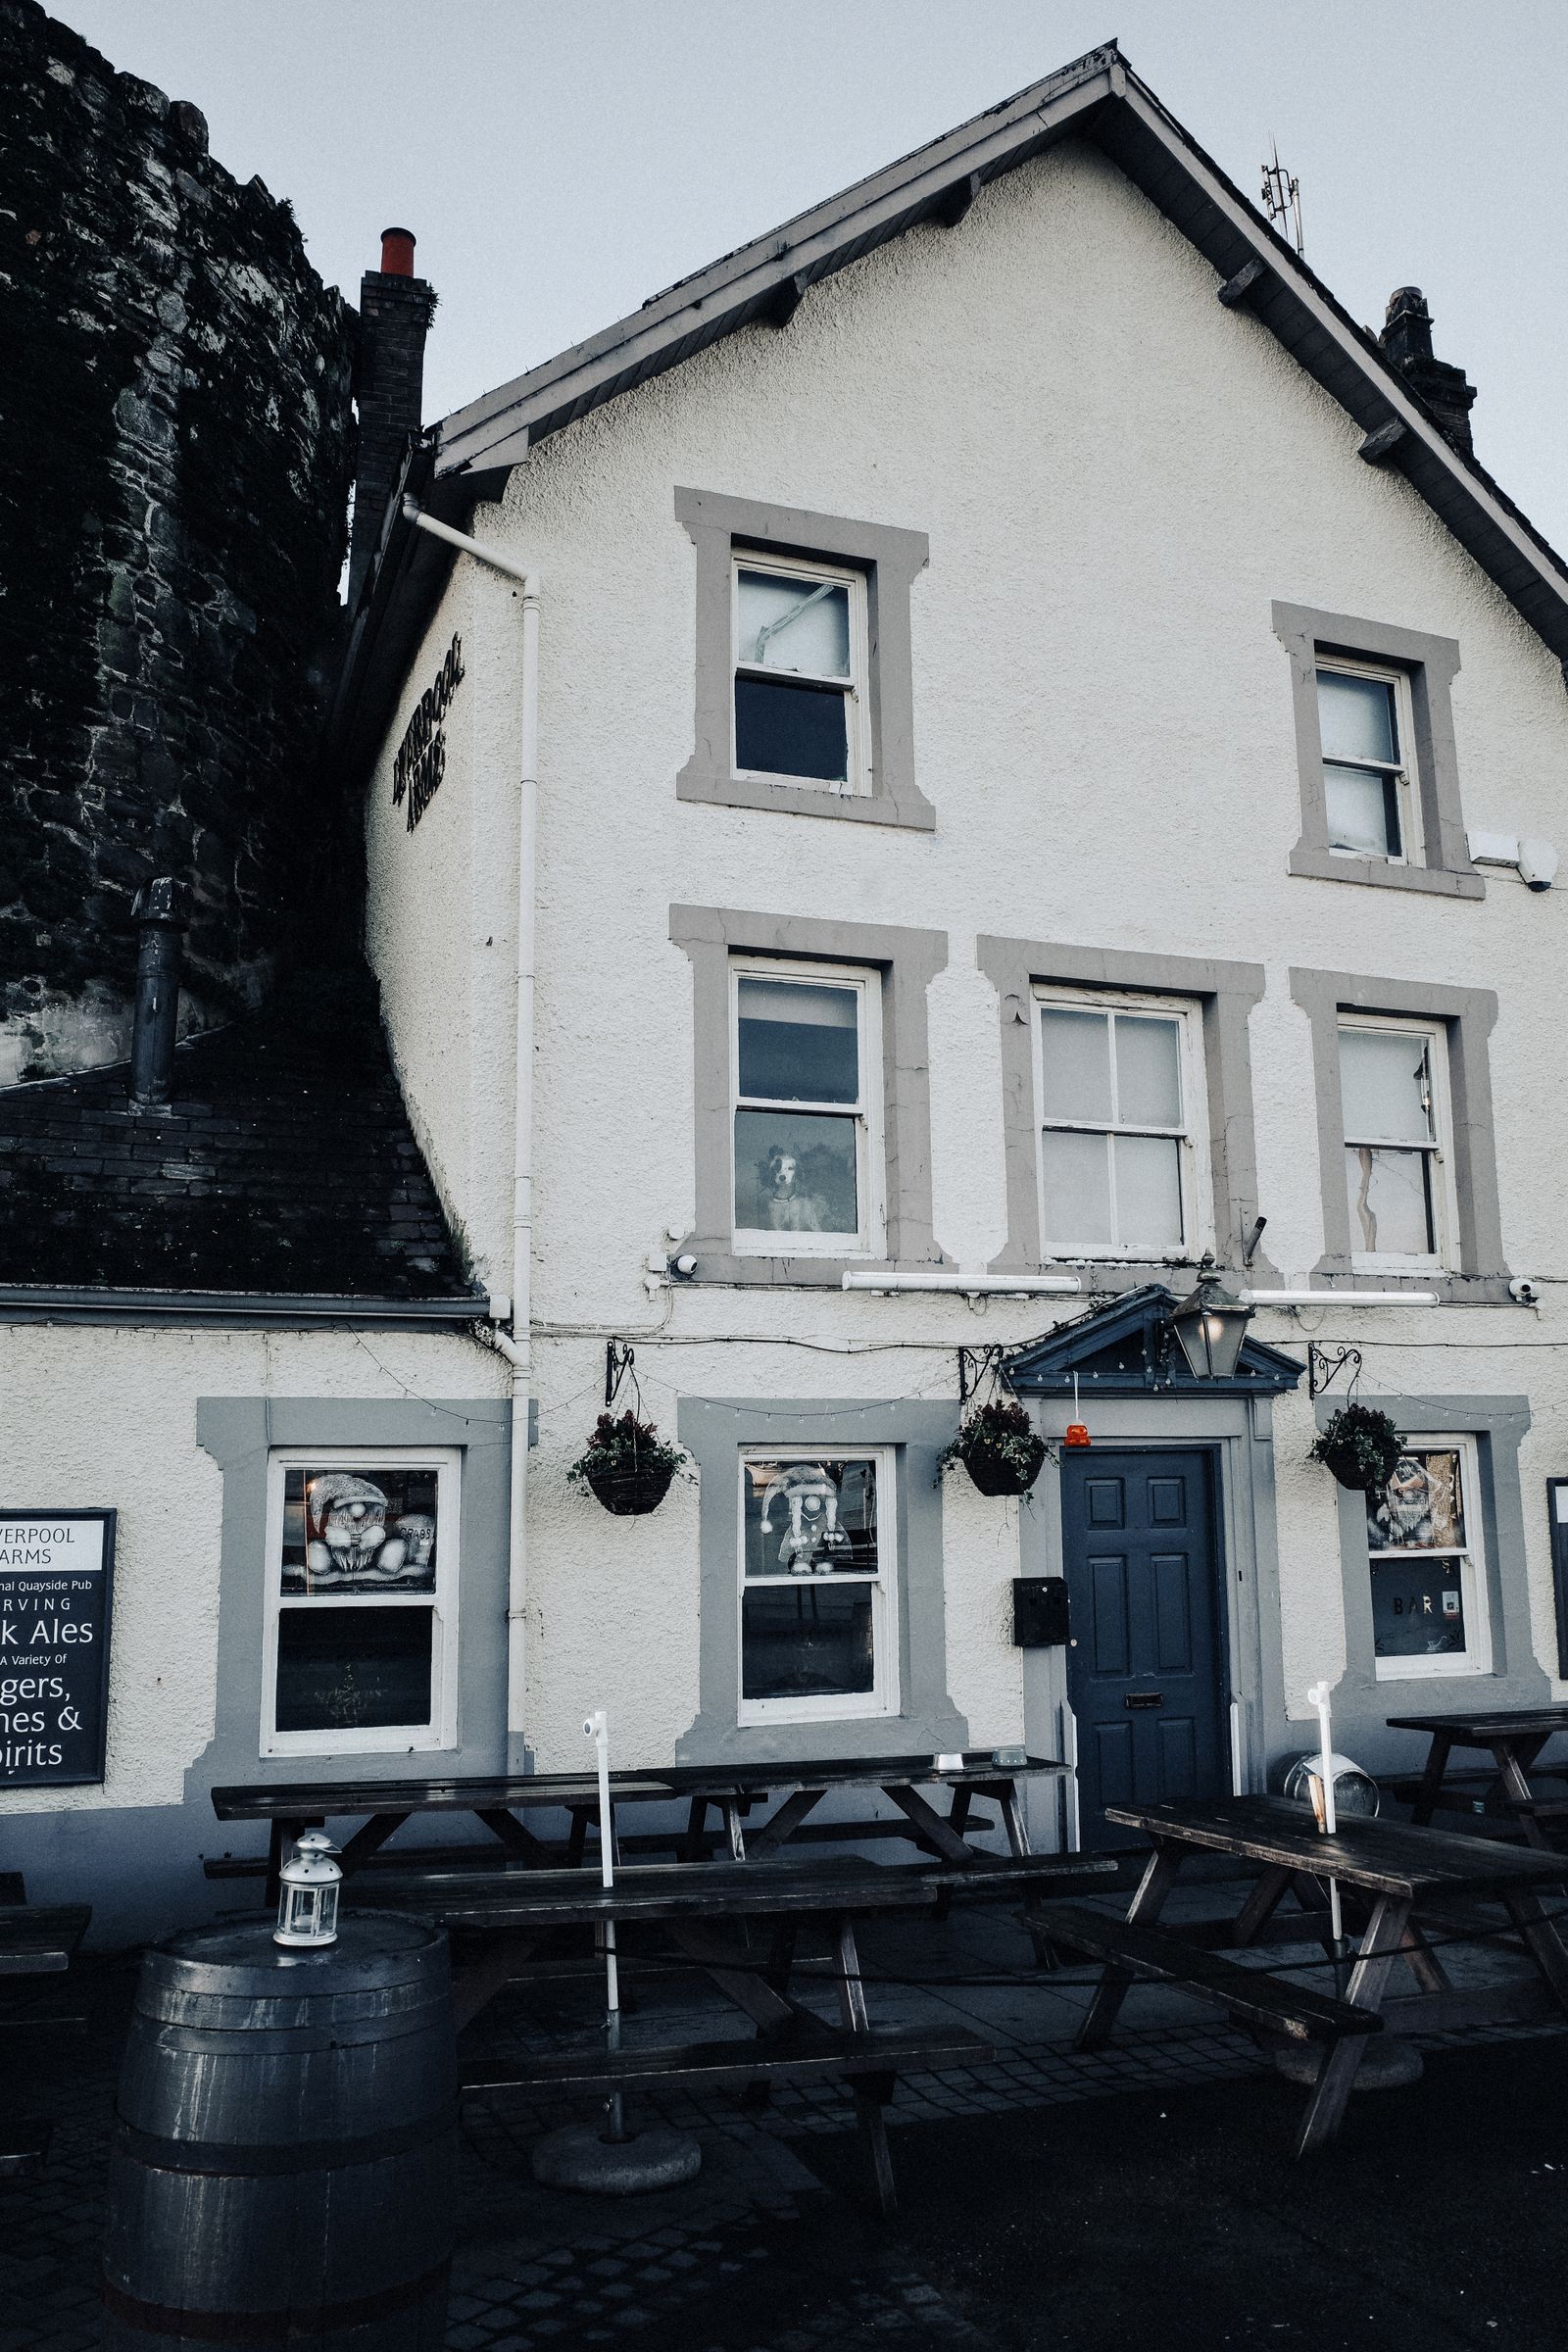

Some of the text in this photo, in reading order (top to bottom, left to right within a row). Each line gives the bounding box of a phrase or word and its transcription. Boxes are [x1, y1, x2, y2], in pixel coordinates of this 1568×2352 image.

[0, 1548, 52, 1564] ARMS
[18, 1580, 69, 1592] Quayside
[72, 1580, 92, 1590] Pub
[3, 1597, 71, 1612] RVING
[1393, 1595, 1434, 1616] BAR
[28, 1618, 93, 1644] Ales
[0, 1653, 68, 1667] A Variety Of
[0, 1677, 71, 1706] gers,
[58, 1706, 83, 1731] &
[0, 1739, 63, 1767] irits
